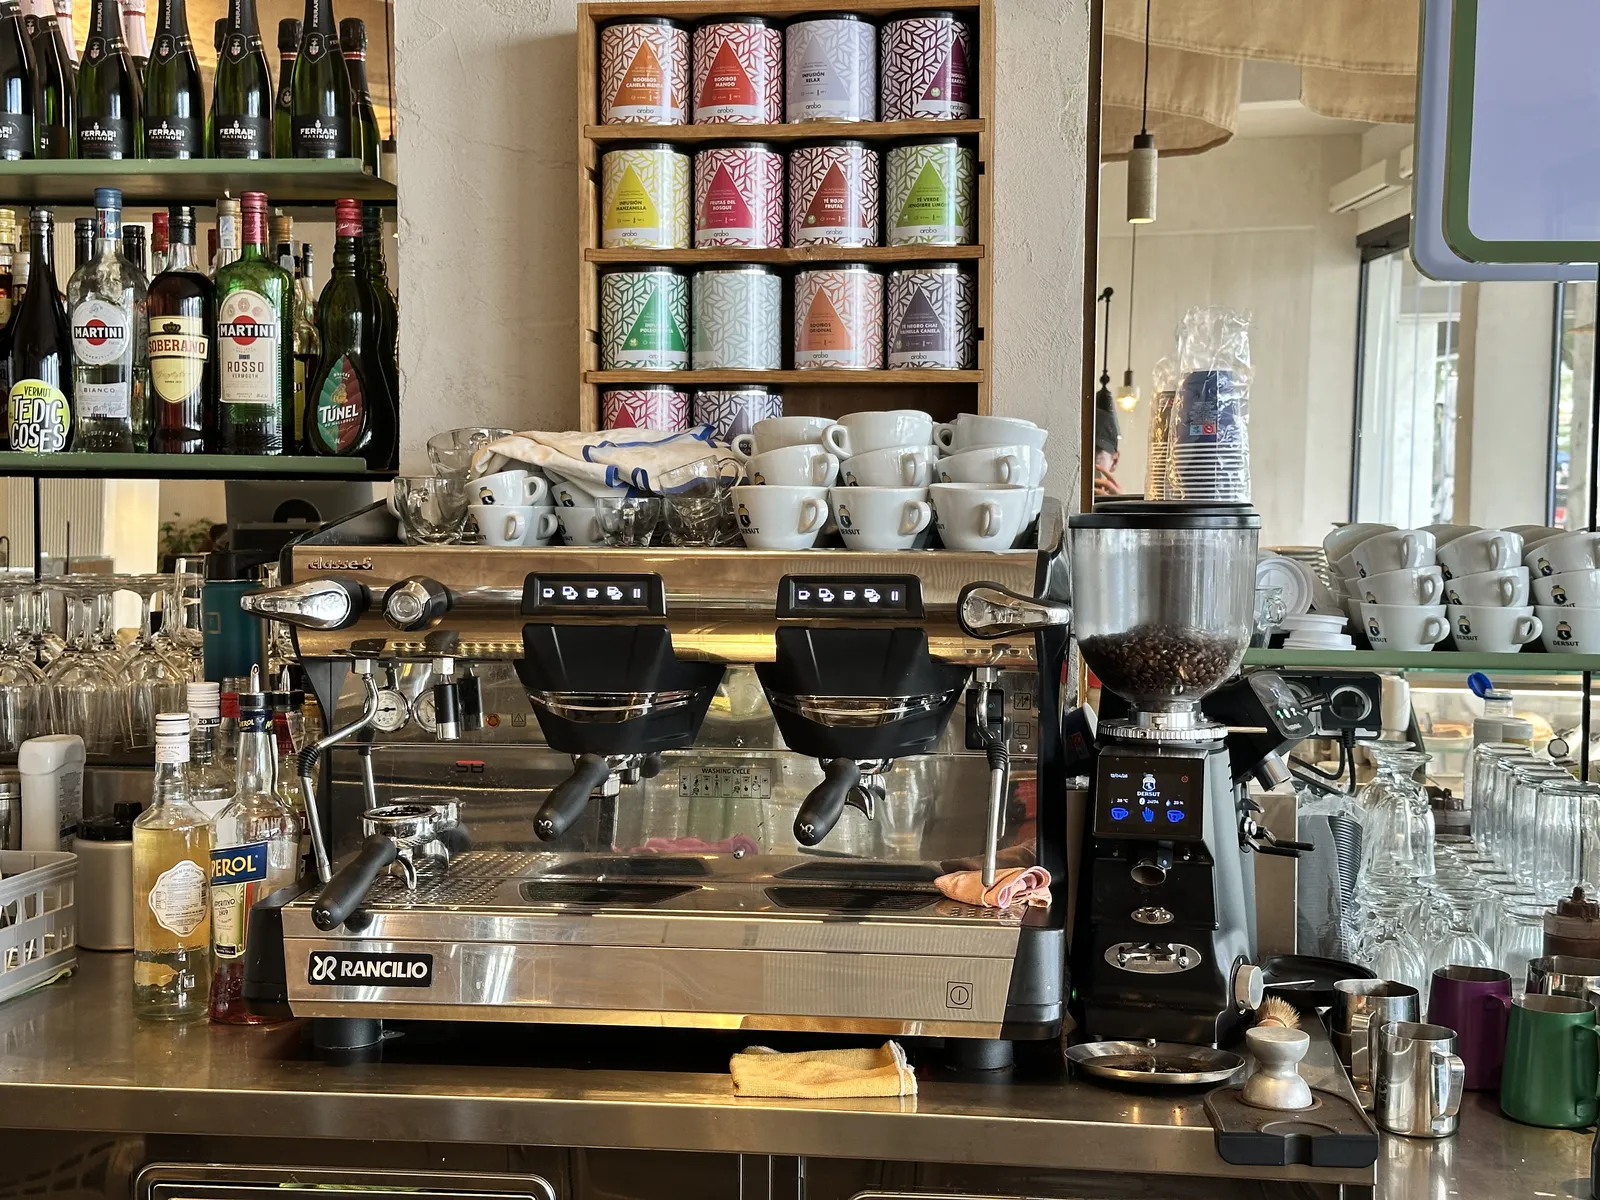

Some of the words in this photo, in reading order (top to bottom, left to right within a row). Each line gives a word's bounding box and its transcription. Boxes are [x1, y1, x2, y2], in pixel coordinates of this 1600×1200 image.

[149, 129, 185, 137] FERRARI
[220, 128, 256, 136] FERRARI
[300, 127, 337, 136] FERRARI
[74, 327, 123, 338] MARTINI
[220, 324, 273, 337] MARTINI
[148, 339, 206, 354] SOBERANO
[227, 361, 264, 373] ROSSO
[24, 386, 52, 397] VERMUT
[319, 404, 359, 424] TÚNEL
[11, 423, 64, 453] COSES
[211, 855, 257, 877] PEROL
[340, 960, 428, 979] RANCILIO
